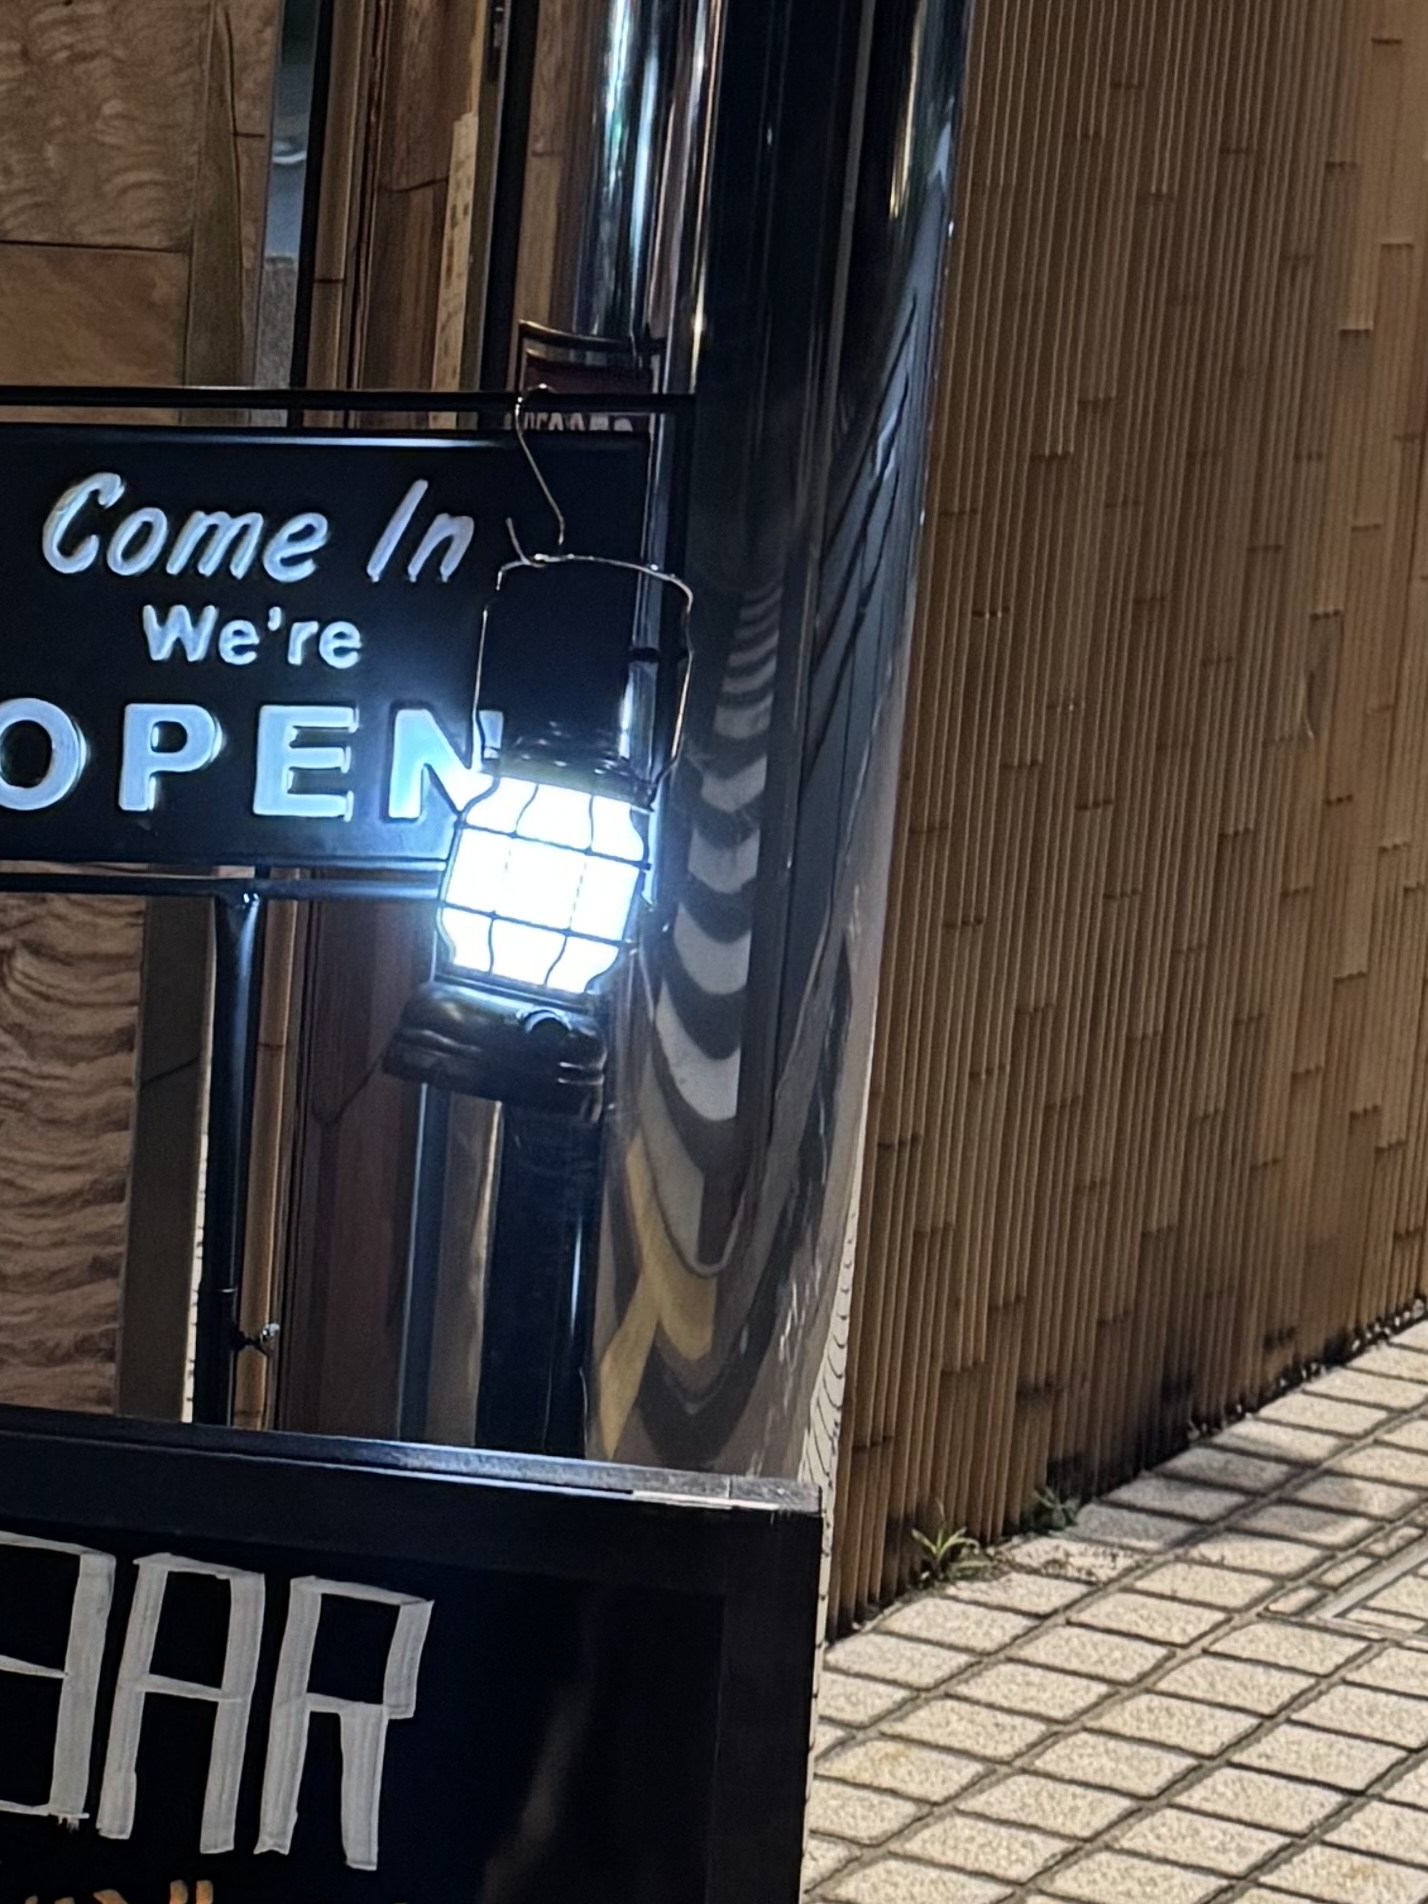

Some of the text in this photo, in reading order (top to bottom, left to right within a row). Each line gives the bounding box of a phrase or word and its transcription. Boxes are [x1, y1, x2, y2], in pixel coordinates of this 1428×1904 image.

[42, 472, 474, 582] Come In
[144, 604, 361, 668] We're
